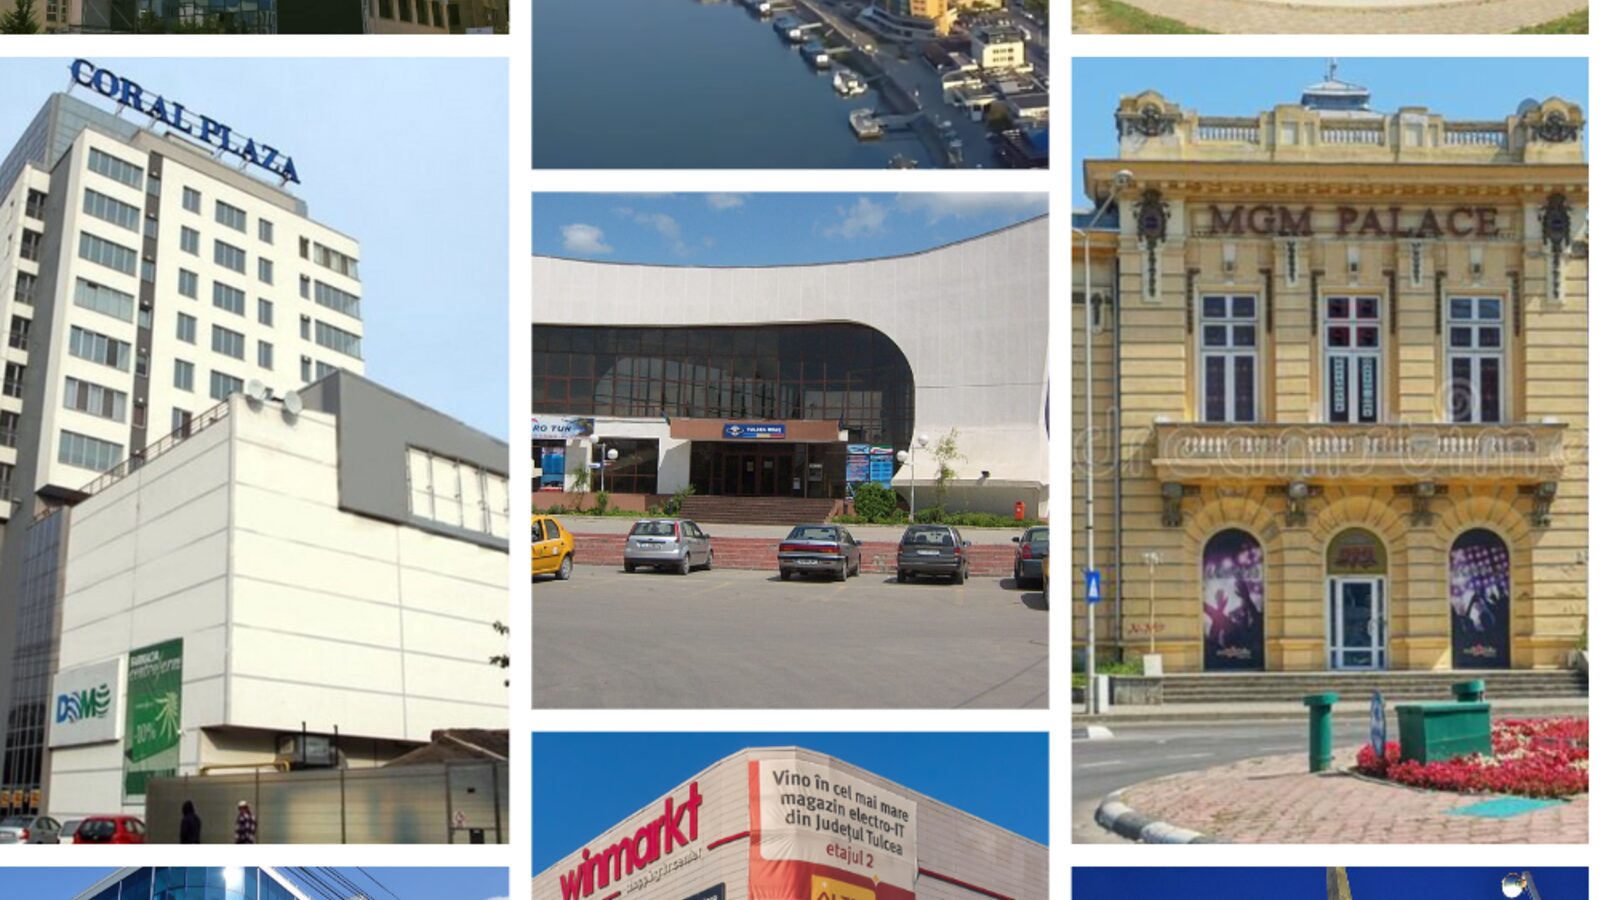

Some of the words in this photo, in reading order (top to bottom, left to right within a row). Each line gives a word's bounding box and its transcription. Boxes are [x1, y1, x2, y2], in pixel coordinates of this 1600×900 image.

[71, 58, 192, 135] CORAL
[199, 114, 301, 185] PLAZA
[1209, 205, 1314, 237] MGM
[1336, 205, 1500, 238] PALACE
[56, 683, 111, 723] DOME
[772, 769, 811, 788] Vino
[814, 774, 829, 792] în
[833, 783, 852, 800] cel
[855, 791, 878, 810] mai
[880, 802, 909, 822] mare
[780, 793, 846, 816] magazin
[849, 807, 905, 838] electro-IT
[560, 781, 703, 900] winmarkt
[785, 809, 811, 827] din
[816, 814, 864, 843] Județul
[866, 829, 903, 856] Tulcea
[826, 842, 864, 866] etajul
[866, 853, 875, 869] 2
